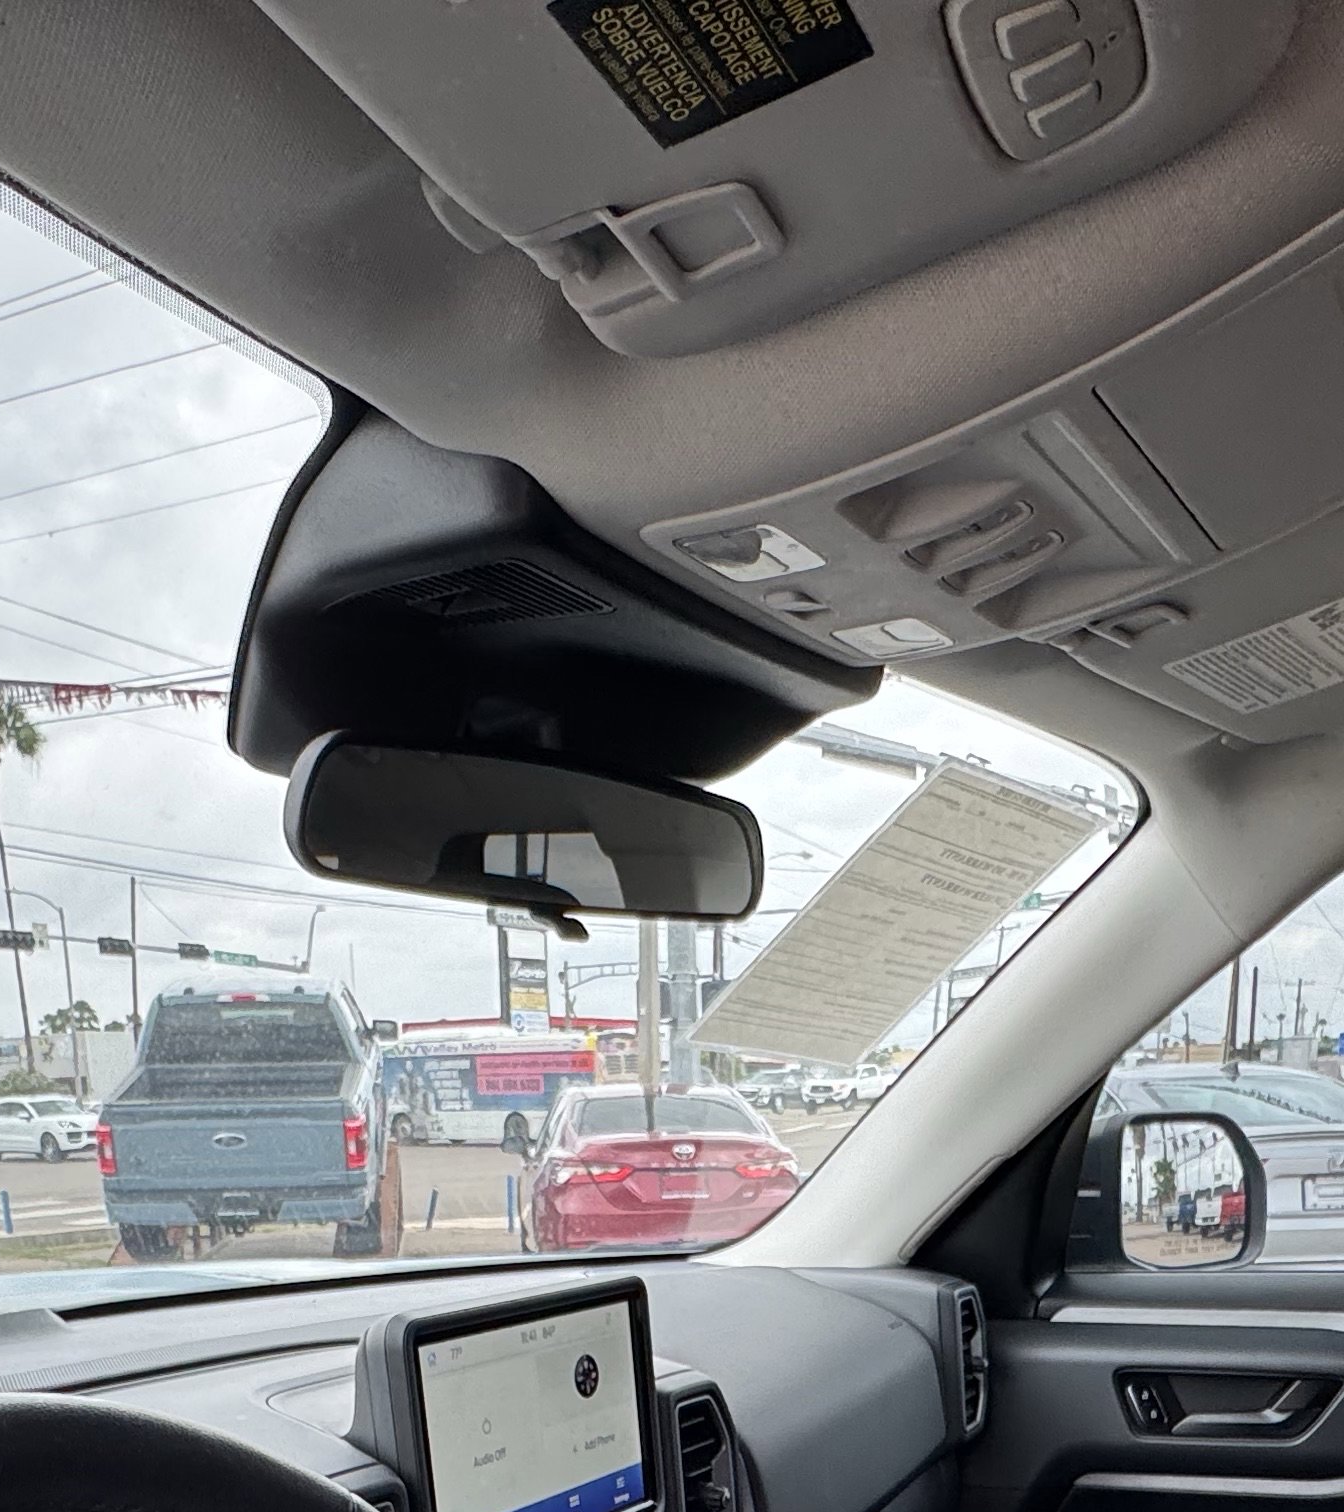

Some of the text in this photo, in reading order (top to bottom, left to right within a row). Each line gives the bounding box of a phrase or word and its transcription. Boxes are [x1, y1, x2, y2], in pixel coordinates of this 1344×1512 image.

[591, 8, 690, 122] SOBRE VUELCO
[618, 3, 707, 109] ADVERTENCIA
[688, 1, 756, 86] CAPOTAGE
